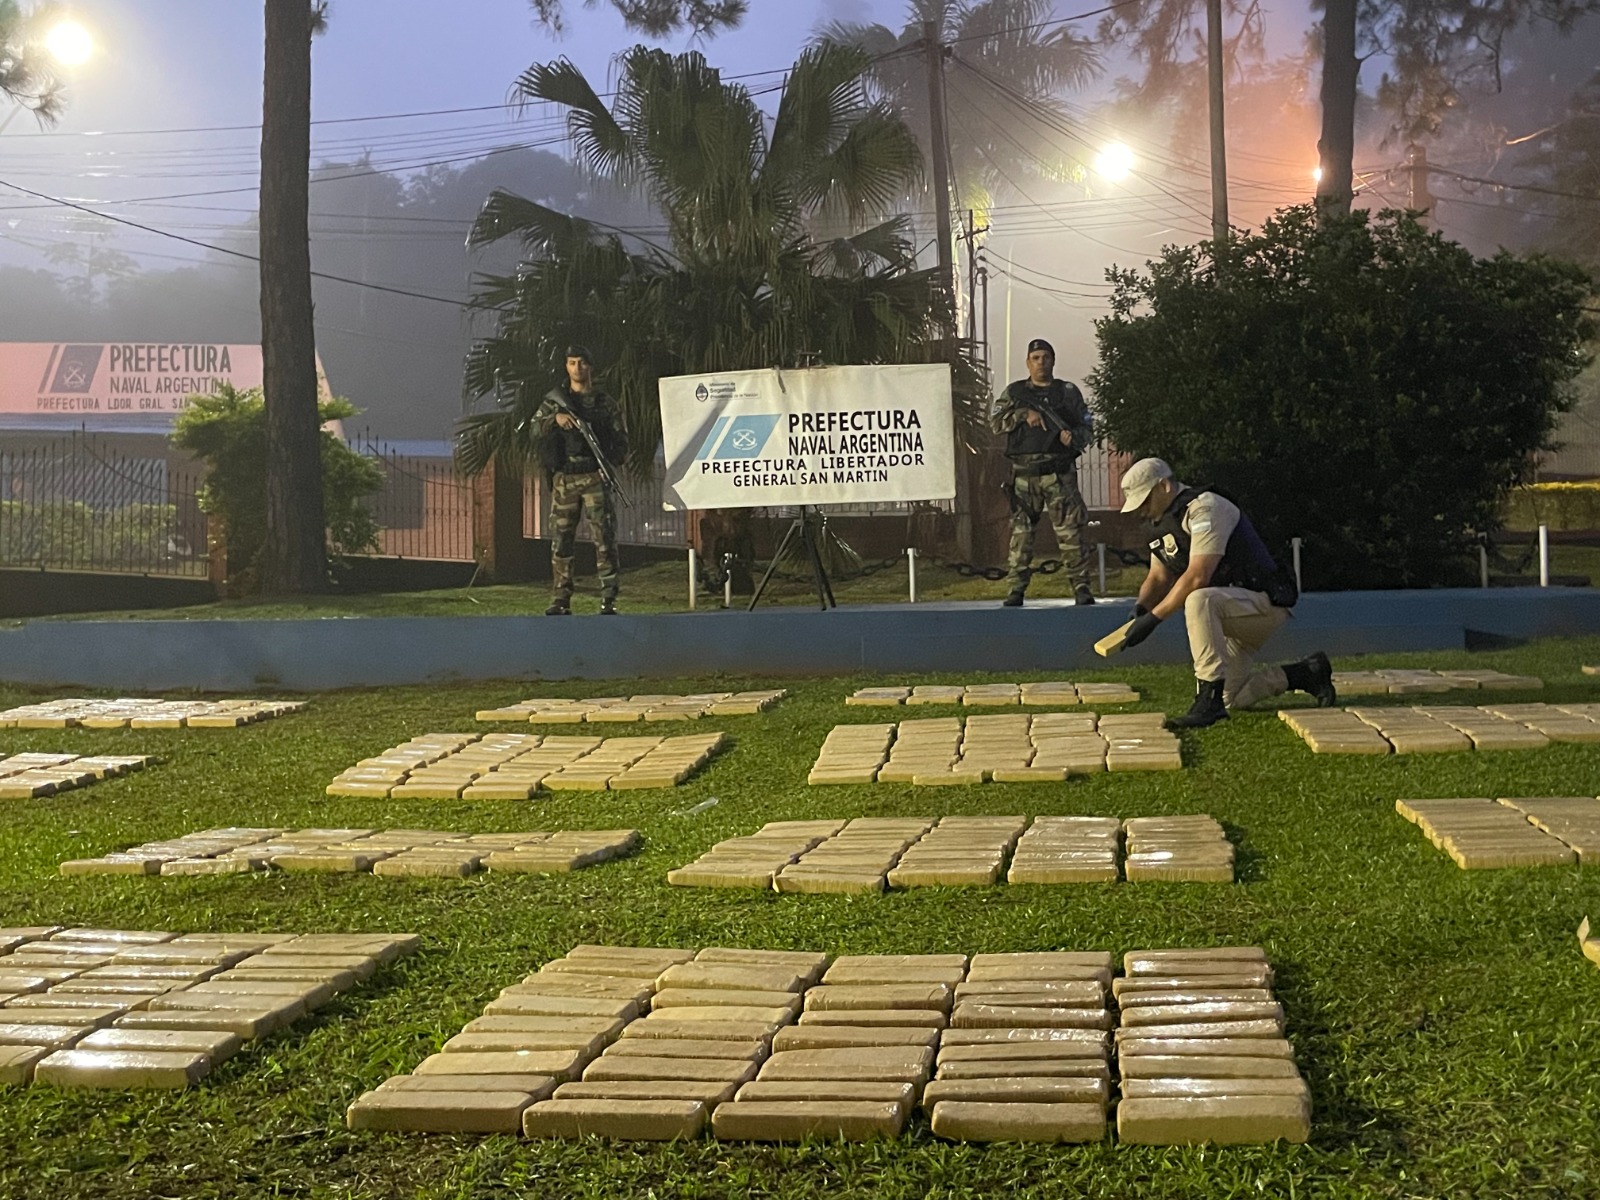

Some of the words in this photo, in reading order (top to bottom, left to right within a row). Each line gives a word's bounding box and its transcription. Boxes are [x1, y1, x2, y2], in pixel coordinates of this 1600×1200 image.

[110, 345, 231, 373] PREFECTURA
[110, 377, 151, 394] NAVAL
[37, 398, 100, 410] PREFECTURA
[789, 409, 921, 433] PREFECTURA
[789, 434, 836, 456] NAVAL
[839, 432, 924, 454] ARGENTINA
[702, 458, 807, 474] PREFECTURA
[821, 454, 925, 469] LIBERTADOR
[733, 473, 796, 487] GENERAL
[801, 470, 828, 484] SAN
[833, 470, 888, 483] MARTIN
